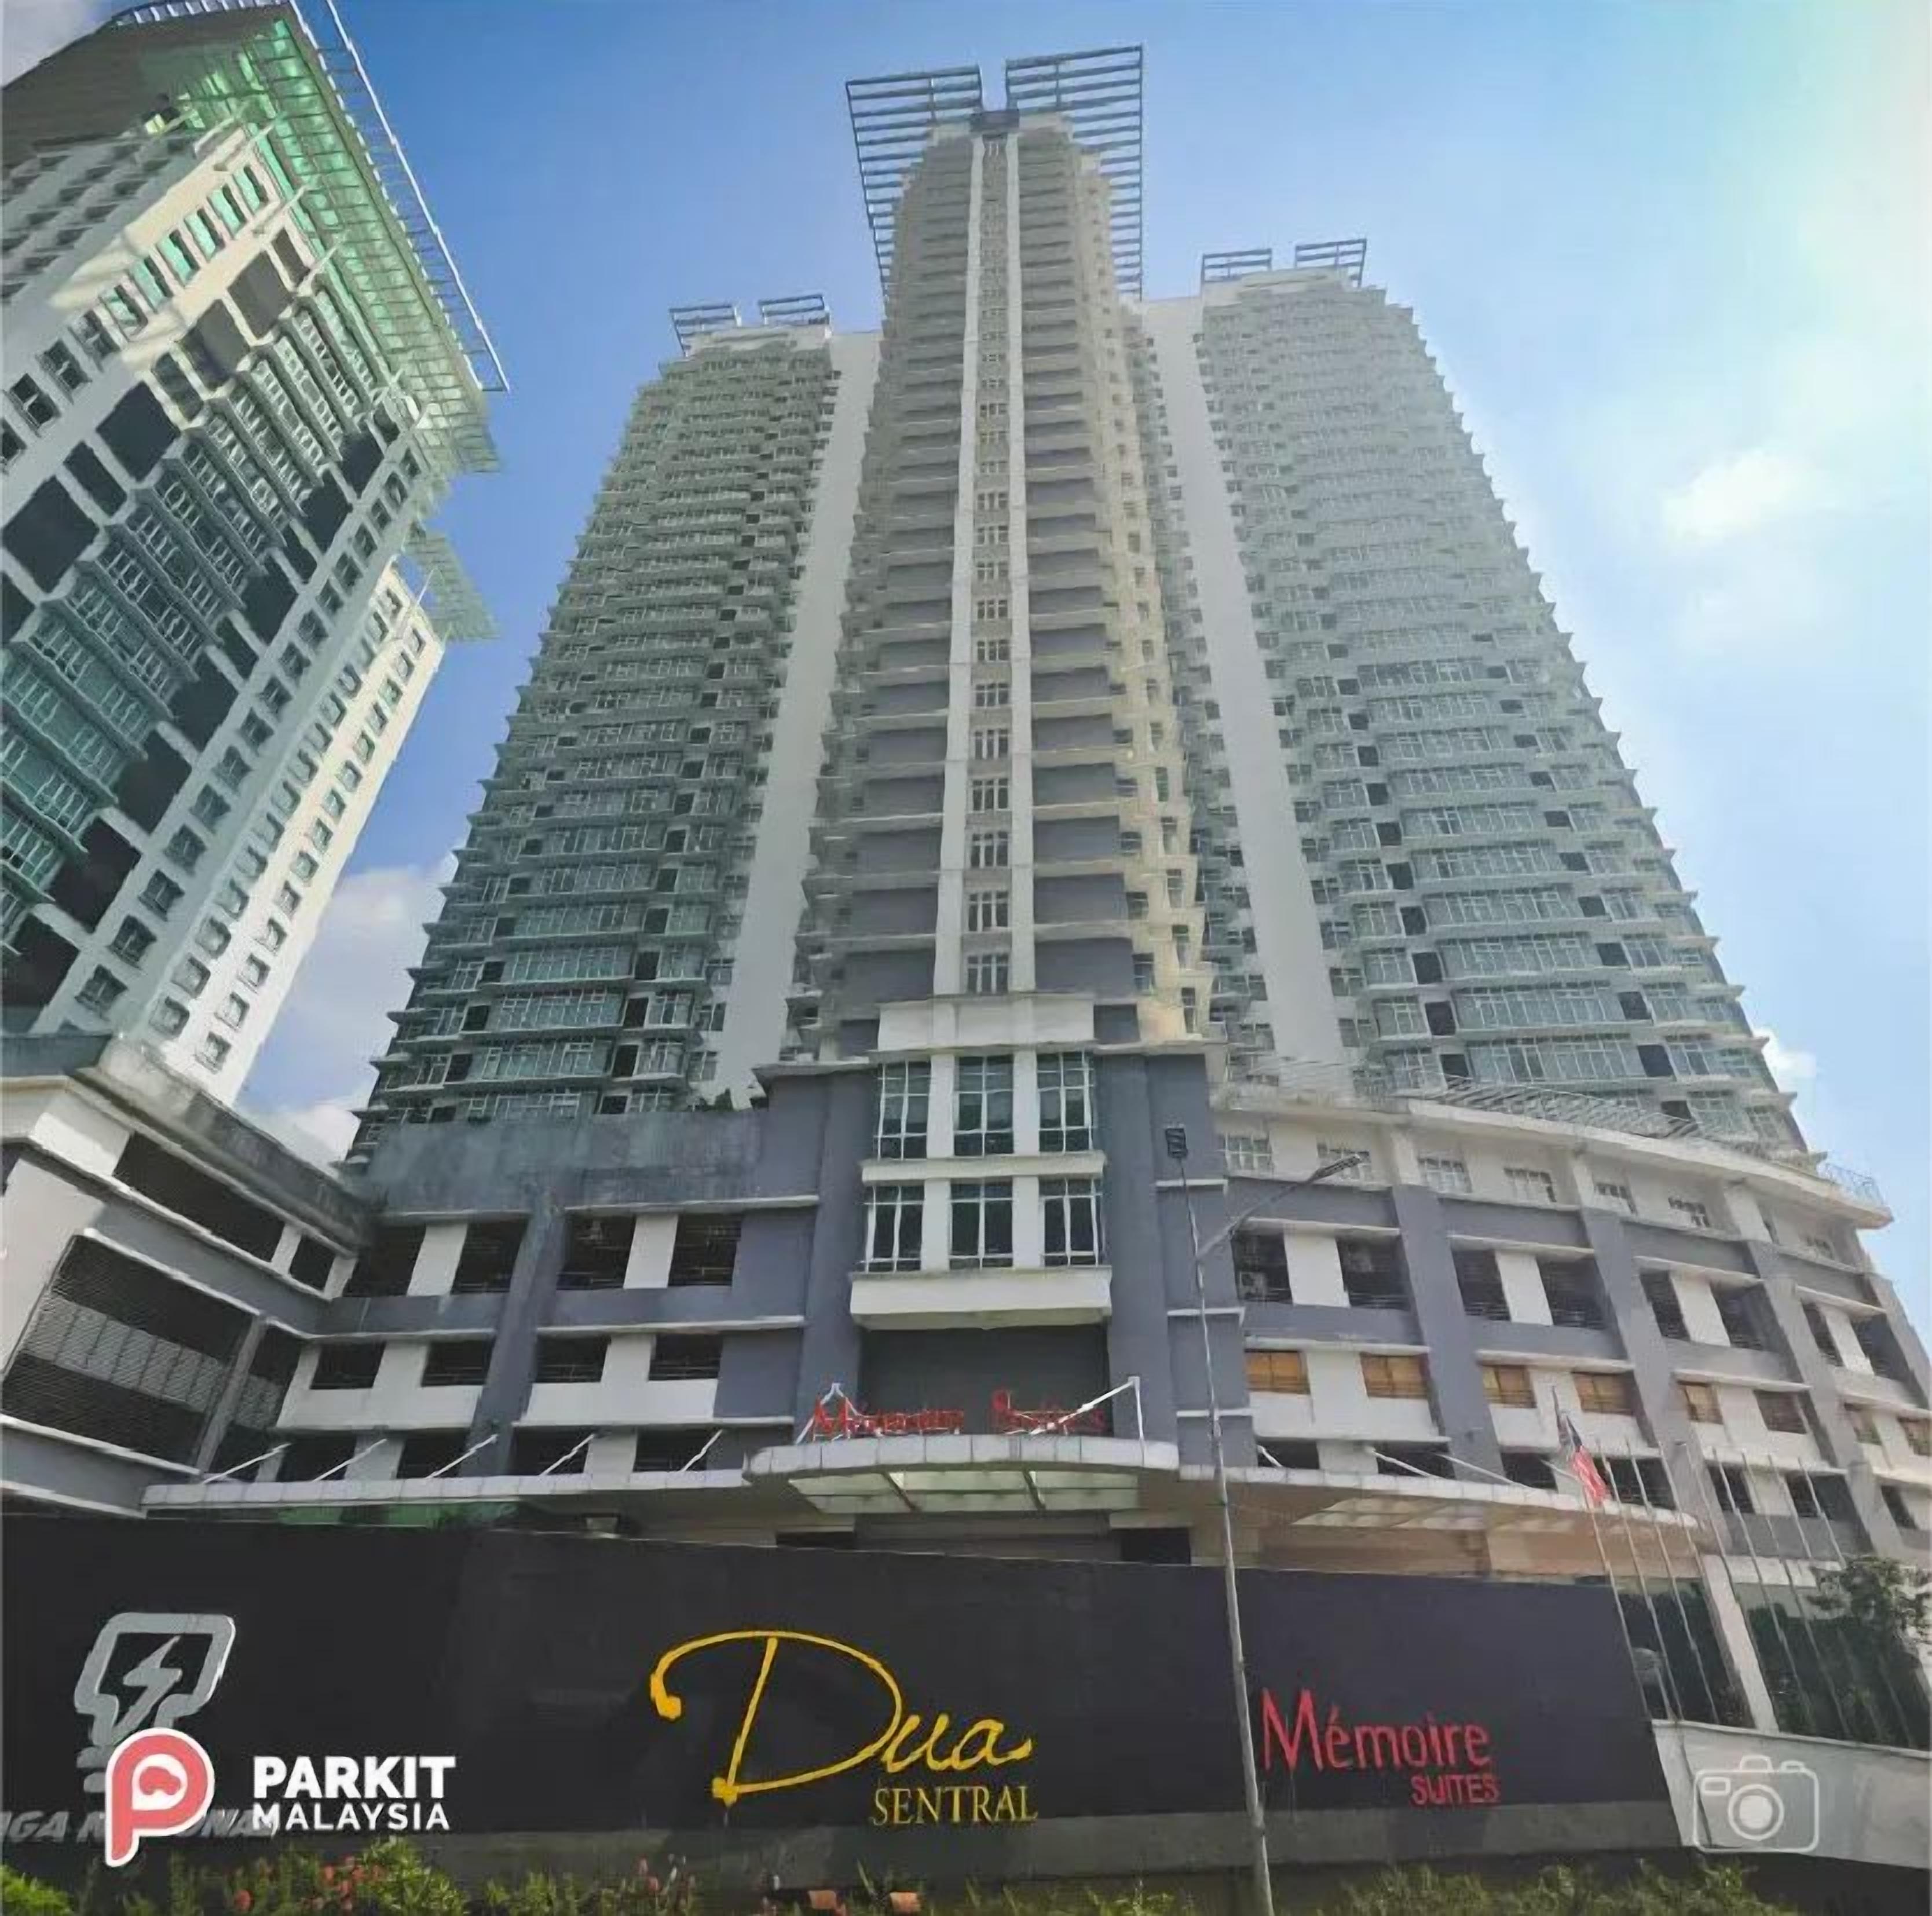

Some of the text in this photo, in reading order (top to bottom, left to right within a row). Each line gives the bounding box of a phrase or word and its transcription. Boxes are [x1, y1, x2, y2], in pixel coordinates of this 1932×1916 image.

[650, 1630, 1032, 1807] Dua
[1261, 1686, 1490, 1771] Mémoire
[873, 1785, 1038, 1826] SENTRAL
[1411, 1774, 1500, 1805] SUITES
